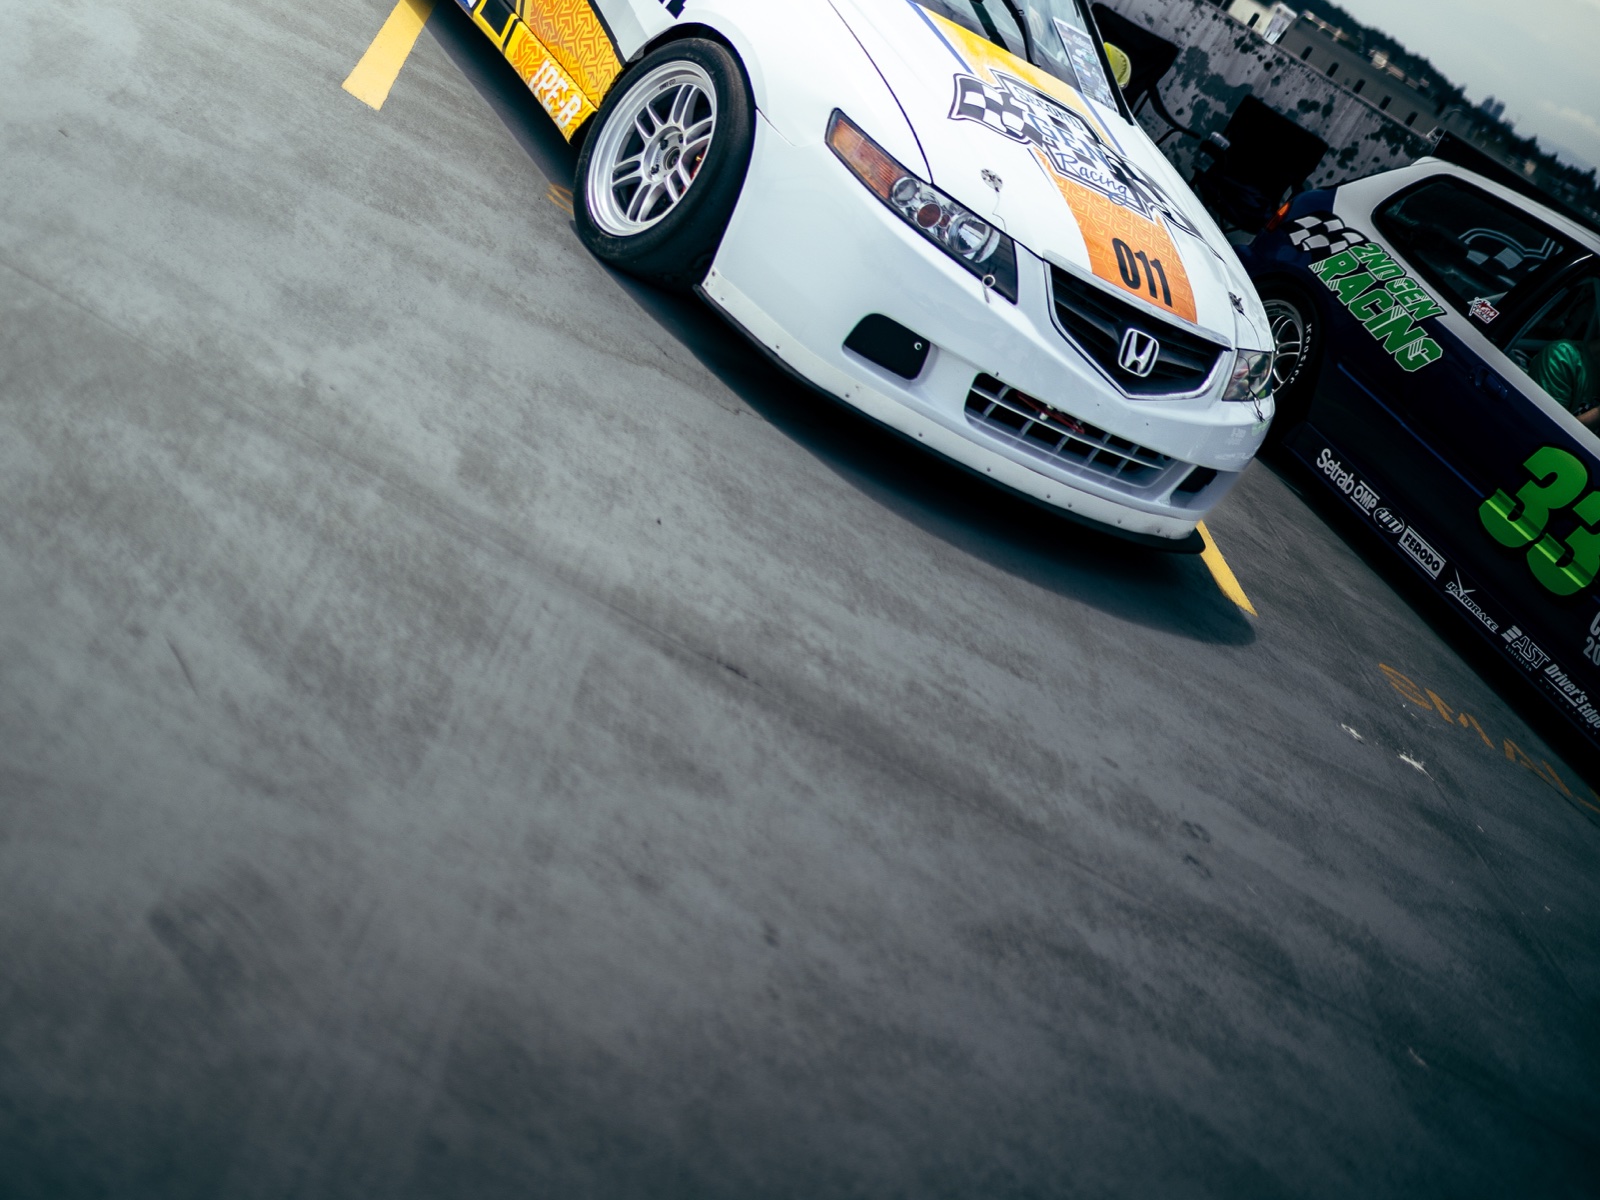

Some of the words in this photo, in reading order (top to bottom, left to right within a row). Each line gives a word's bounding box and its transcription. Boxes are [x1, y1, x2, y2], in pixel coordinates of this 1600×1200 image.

[1014, 87, 1082, 130] SECOND
[1025, 113, 1117, 174] GEN
[1056, 152, 1135, 205] Racing
[1112, 238, 1172, 307] 011
[1348, 242, 1406, 281] 2ND
[1385, 276, 1446, 321] GEN
[1308, 250, 1443, 372] RACING
[1317, 448, 1354, 494] Setrab
[1353, 484, 1378, 511] OMP
[1403, 532, 1441, 571] FERODO
[1445, 580, 1499, 634] HARDRACE
[1544, 663, 1588, 704] Driver's
